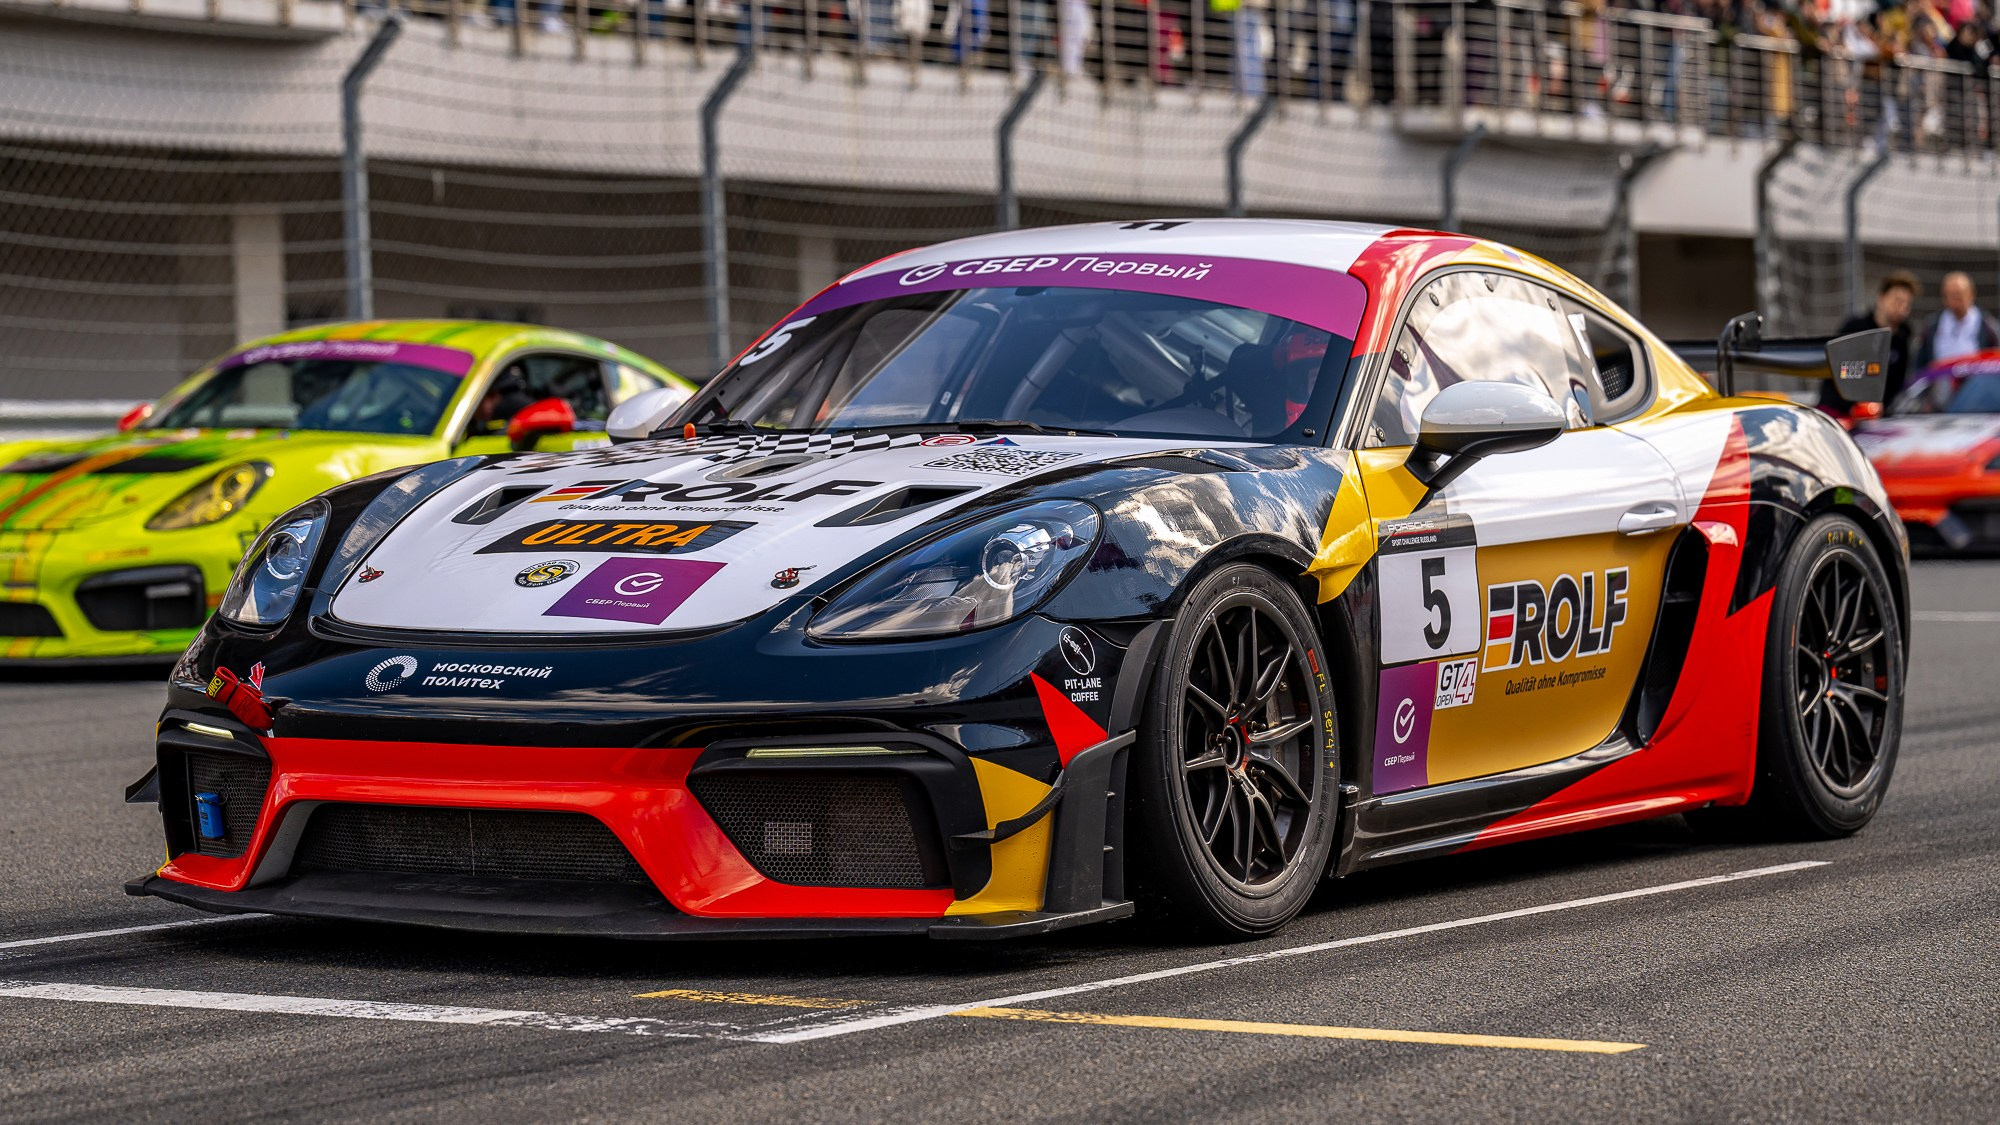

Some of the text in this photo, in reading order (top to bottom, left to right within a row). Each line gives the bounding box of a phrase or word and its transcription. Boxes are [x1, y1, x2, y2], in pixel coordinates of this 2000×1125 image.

[952, 256, 1214, 281] СБЕР Первый
[739, 315, 818, 367] 5
[579, 478, 886, 503] ROLF
[521, 522, 713, 547] ULTRA
[1387, 520, 1435, 533] PORSCHE
[585, 598, 651, 610] СБЕР Первый
[1420, 556, 1452, 650] 5
[1510, 567, 1629, 665] ROLF
[207, 677, 223, 697] OMP
[1064, 677, 1102, 690] PIT-LANE
[1440, 660, 1477, 704] GT4
[1505, 665, 1607, 696] Qualität ohne Kompromisse
[1071, 691, 1100, 703] COFFEE
[1436, 693, 1455, 707] OPEN
[1384, 754, 1398, 767] СБЕР
